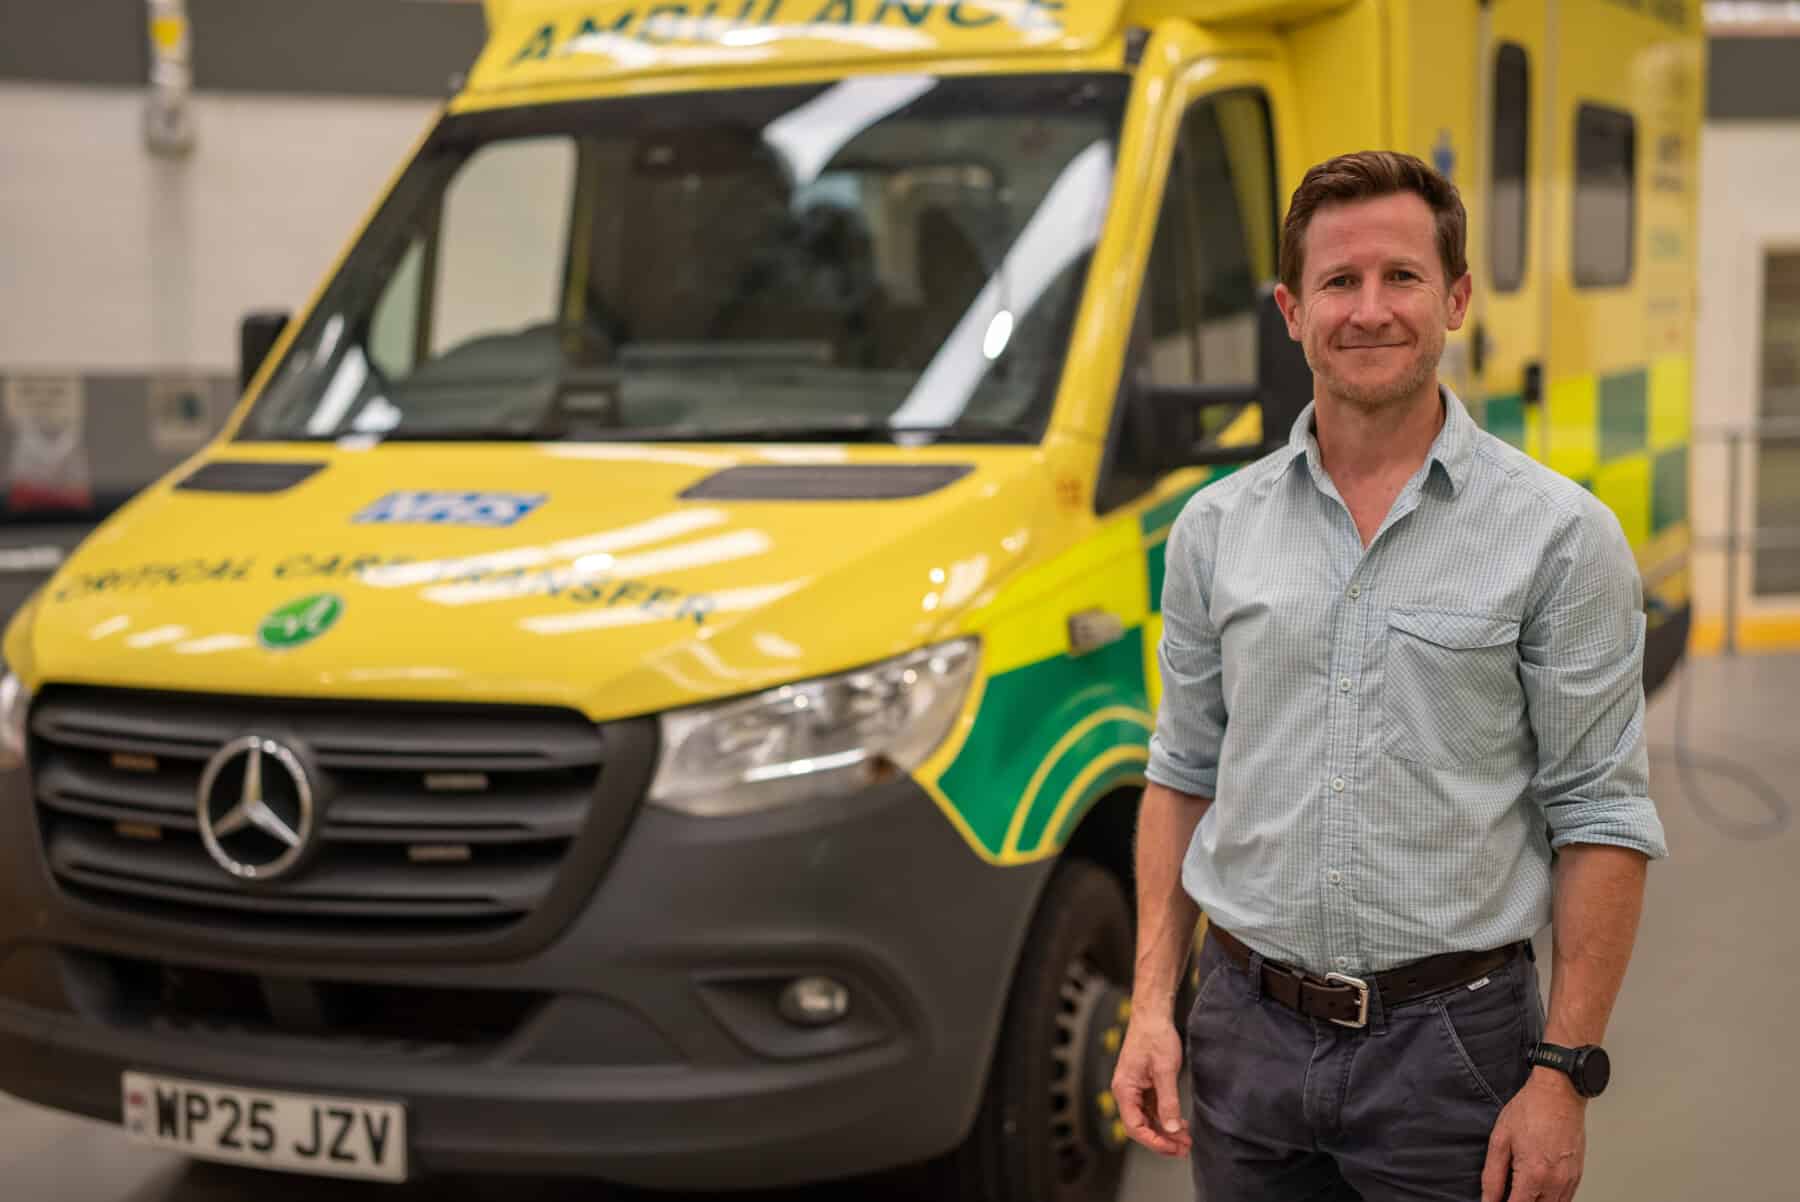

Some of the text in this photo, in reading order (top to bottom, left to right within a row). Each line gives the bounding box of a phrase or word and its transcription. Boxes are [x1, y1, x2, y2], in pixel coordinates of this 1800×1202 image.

[362, 490, 532, 527] NHS
[424, 556, 718, 625] RANSFER
[153, 1083, 390, 1166] WP25 JZV
